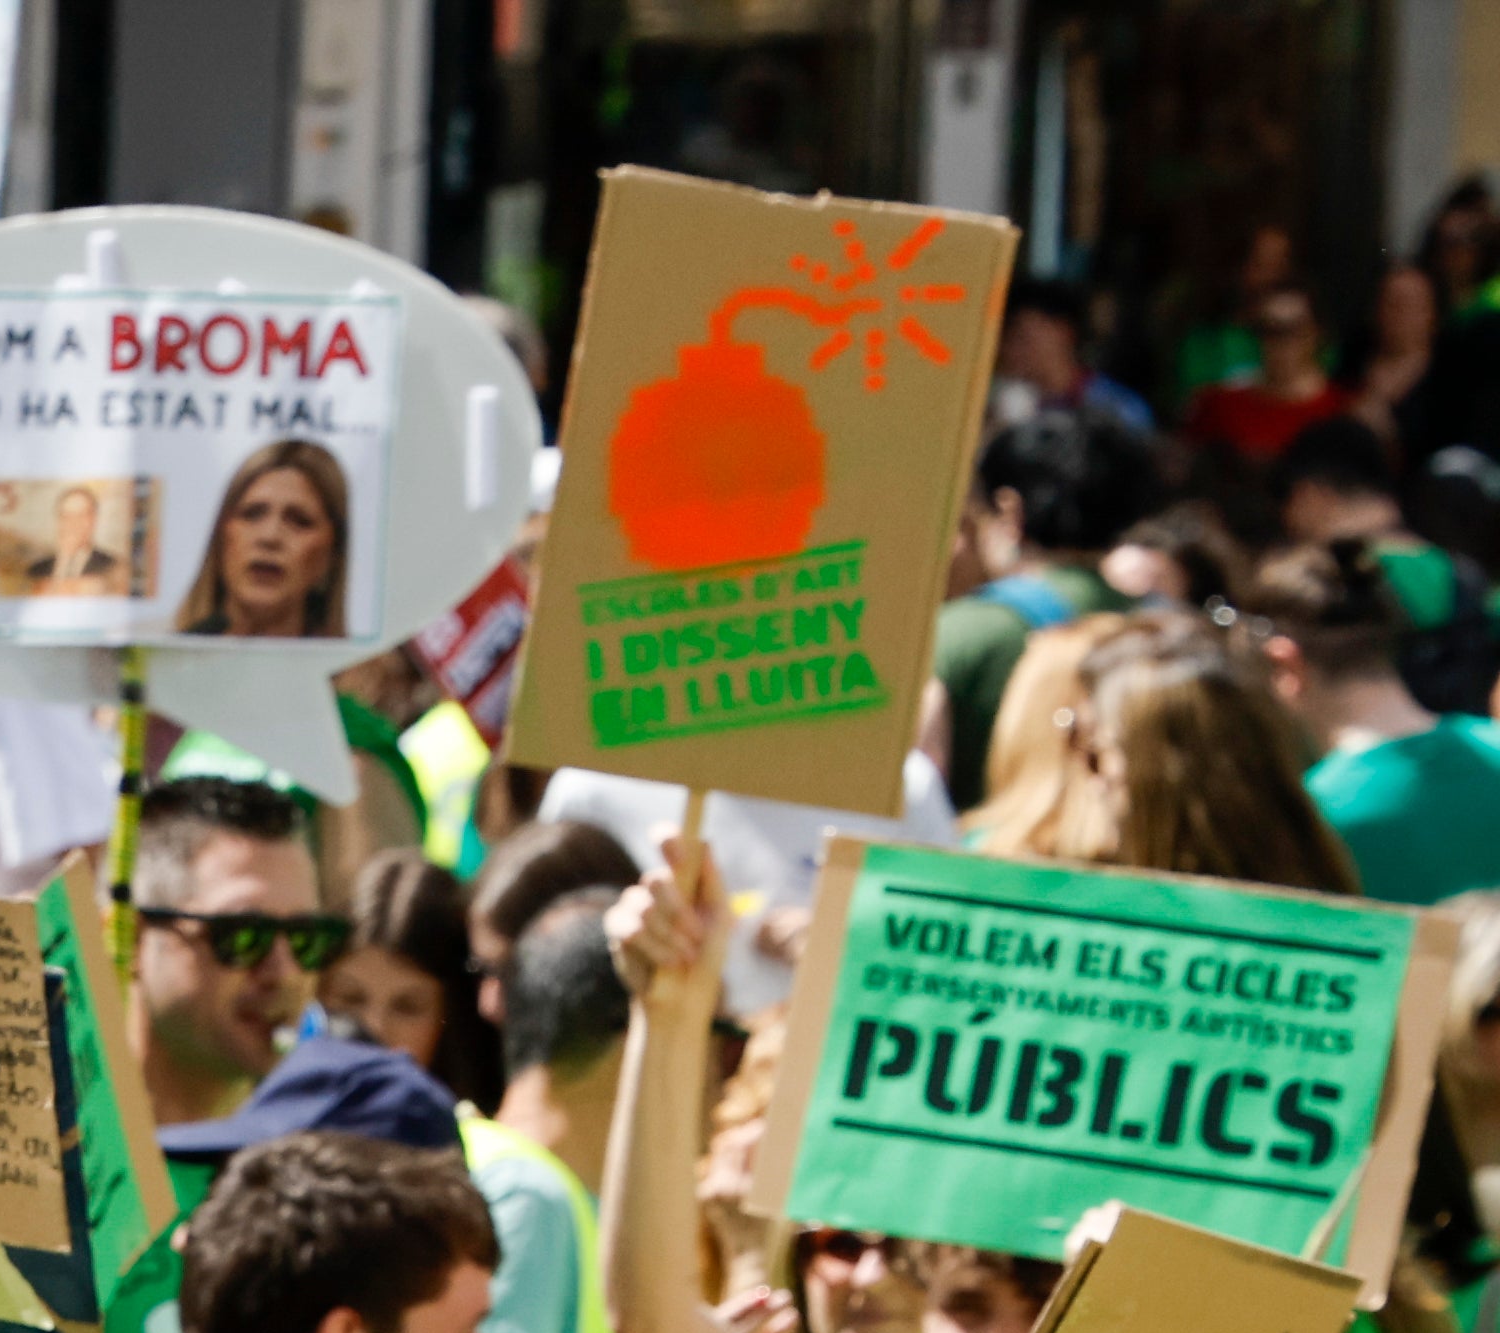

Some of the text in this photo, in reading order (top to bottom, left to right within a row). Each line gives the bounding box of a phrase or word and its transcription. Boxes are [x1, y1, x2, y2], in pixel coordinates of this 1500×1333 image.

[55, 326, 86, 360] A
[110, 312, 369, 378] BROMA
[19, 391, 80, 427] HA
[100, 392, 230, 431] ESTAT
[587, 637, 604, 681] I
[622, 597, 866, 676] DISSENY
[884, 911, 1359, 1015] VOLEM ELS CICLES
[842, 1008, 1342, 1169] PÚBLICS
